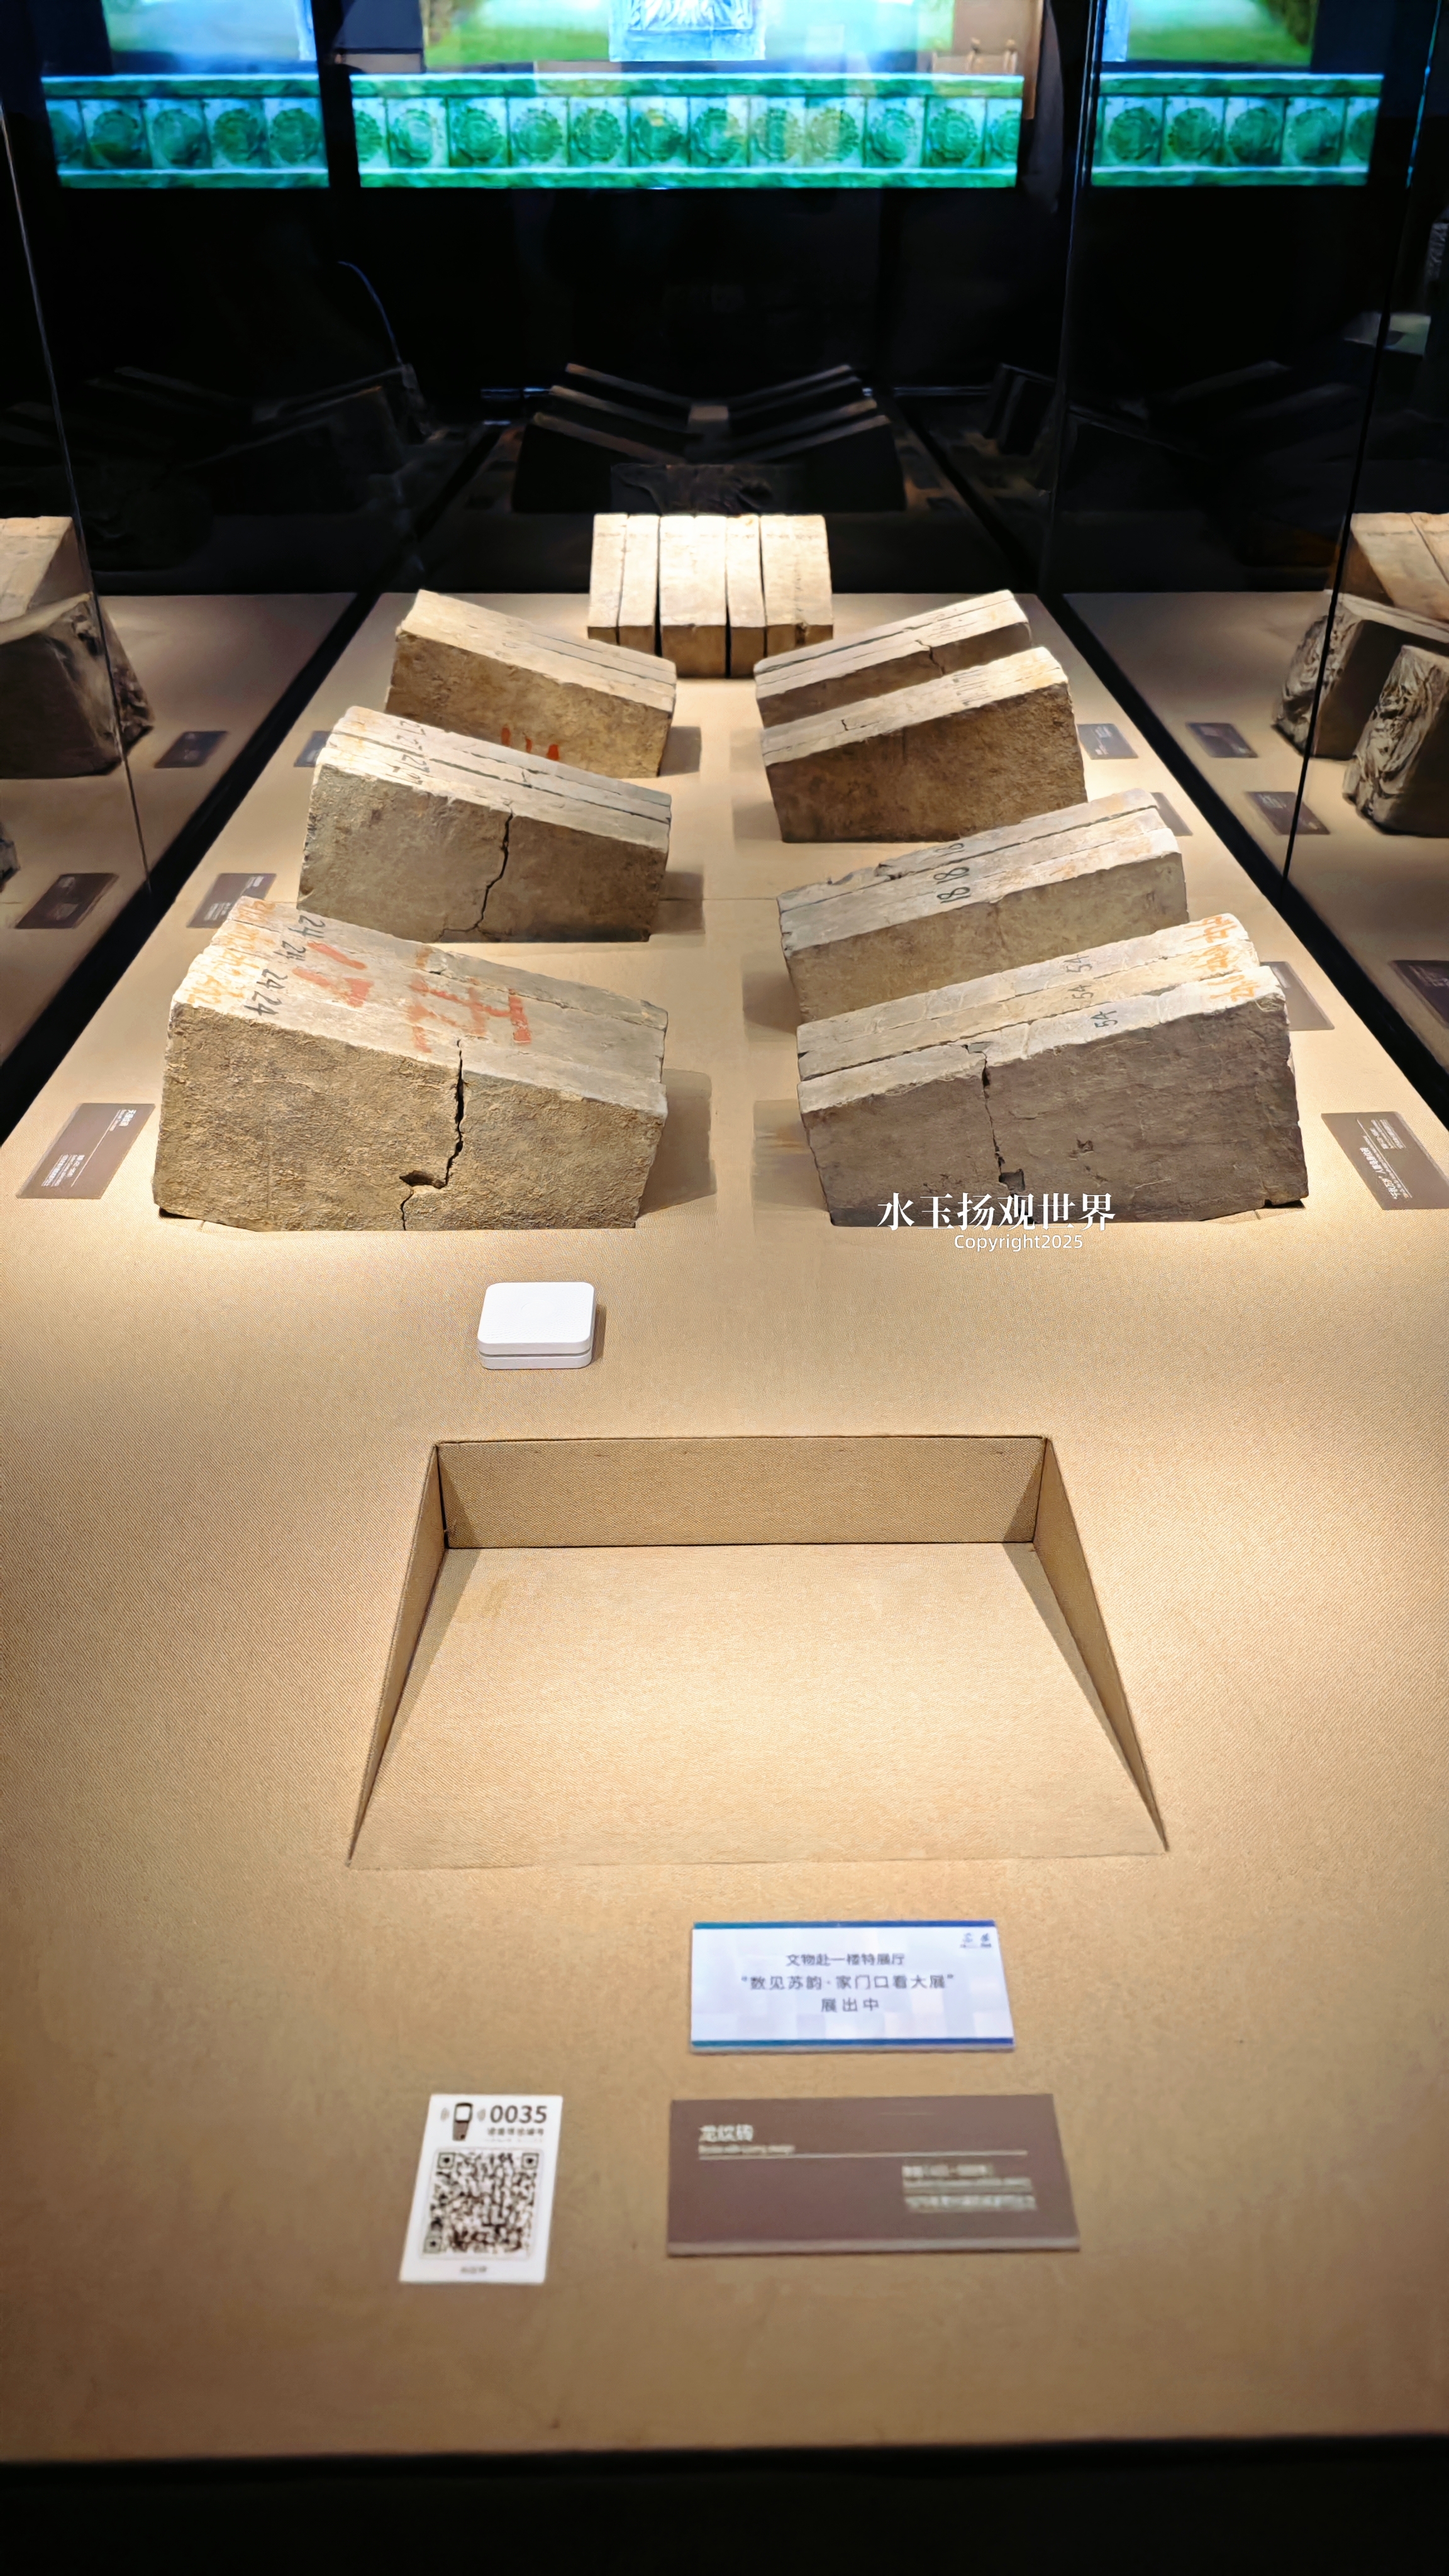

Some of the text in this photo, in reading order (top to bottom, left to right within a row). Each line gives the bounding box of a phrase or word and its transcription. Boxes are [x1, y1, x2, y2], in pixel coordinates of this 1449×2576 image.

[933, 867, 970, 885] 18
[936, 886, 972, 904] 18
[287, 914, 326, 939] 24
[272, 940, 306, 962] 24
[1063, 954, 1093, 973] 54
[256, 962, 289, 989] 24
[1067, 984, 1094, 999] 54
[244, 991, 283, 1016] 24
[1090, 1011, 1118, 1028] 54
[786, 1953, 905, 1967] 文物赴一楼特展厅
[821, 1997, 880, 2013] 展出中
[490, 2104, 548, 2124] 0035
